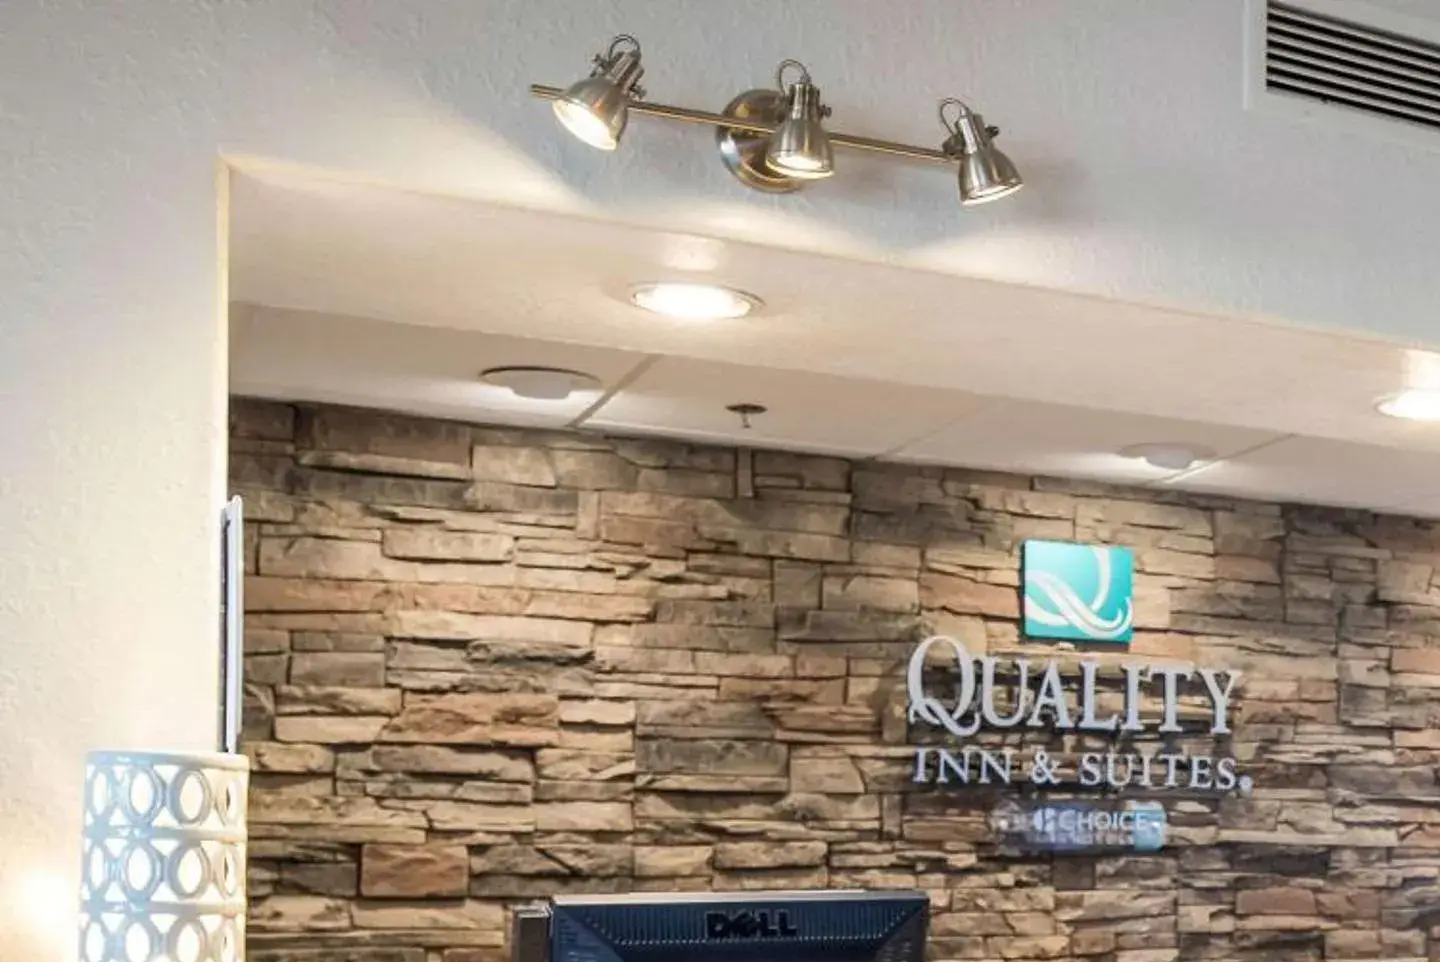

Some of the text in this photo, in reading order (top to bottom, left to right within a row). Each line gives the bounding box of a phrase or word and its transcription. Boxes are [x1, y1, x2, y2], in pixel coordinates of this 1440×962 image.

[907, 635, 1242, 736] QUALITY
[913, 746, 1012, 785] INN
[1031, 748, 1062, 785] &
[1058, 810, 1148, 831] CHOICE
[706, 911, 799, 938] DELL
